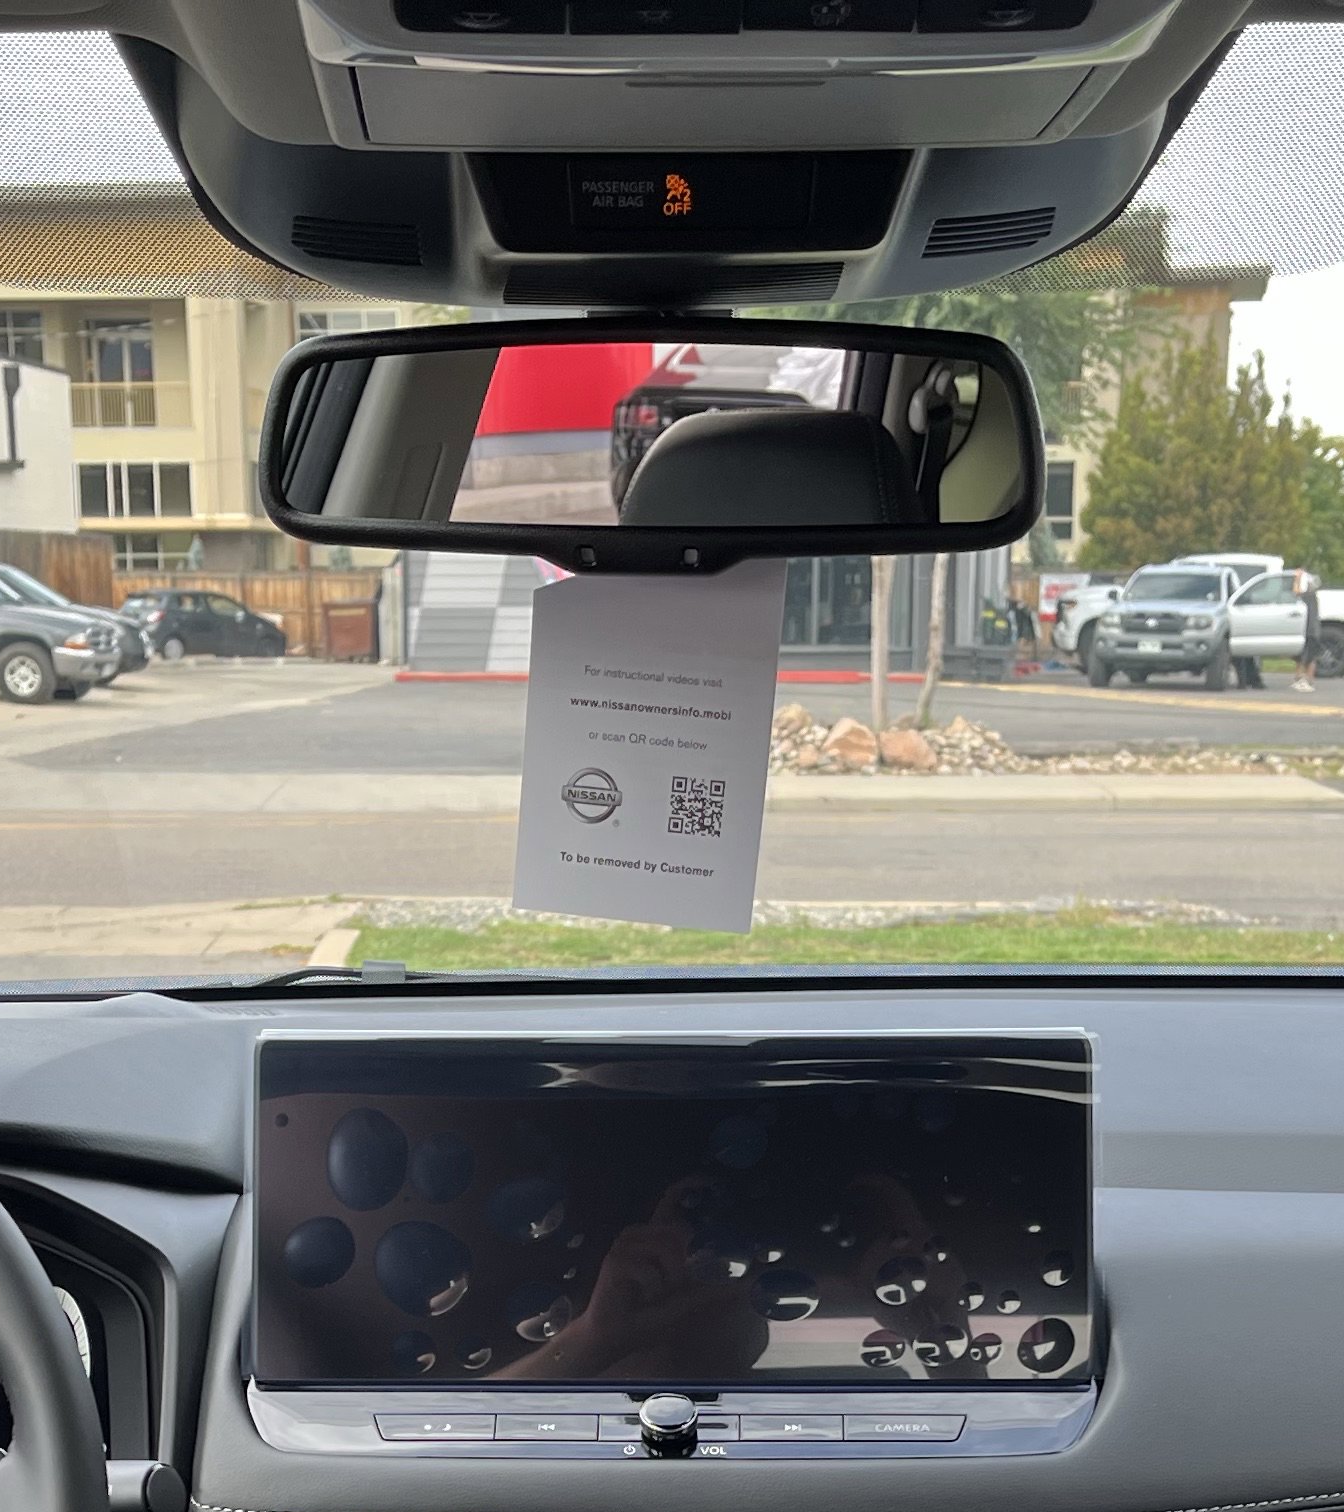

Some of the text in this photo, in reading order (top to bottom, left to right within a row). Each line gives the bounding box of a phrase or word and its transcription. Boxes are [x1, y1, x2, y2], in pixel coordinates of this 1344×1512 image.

[582, 180, 655, 194] PASSENGER
[592, 195, 644, 208] AIR BAG
[663, 202, 692, 216] OFF
[584, 665, 723, 688] For instructional videos visit
[588, 731, 708, 751] or scan QR code below
[567, 788, 617, 802] NISSAN
[559, 851, 715, 878] To be removed by Customer
[874, 1423, 931, 1433] CAMERA
[699, 1446, 727, 1455] VOL
